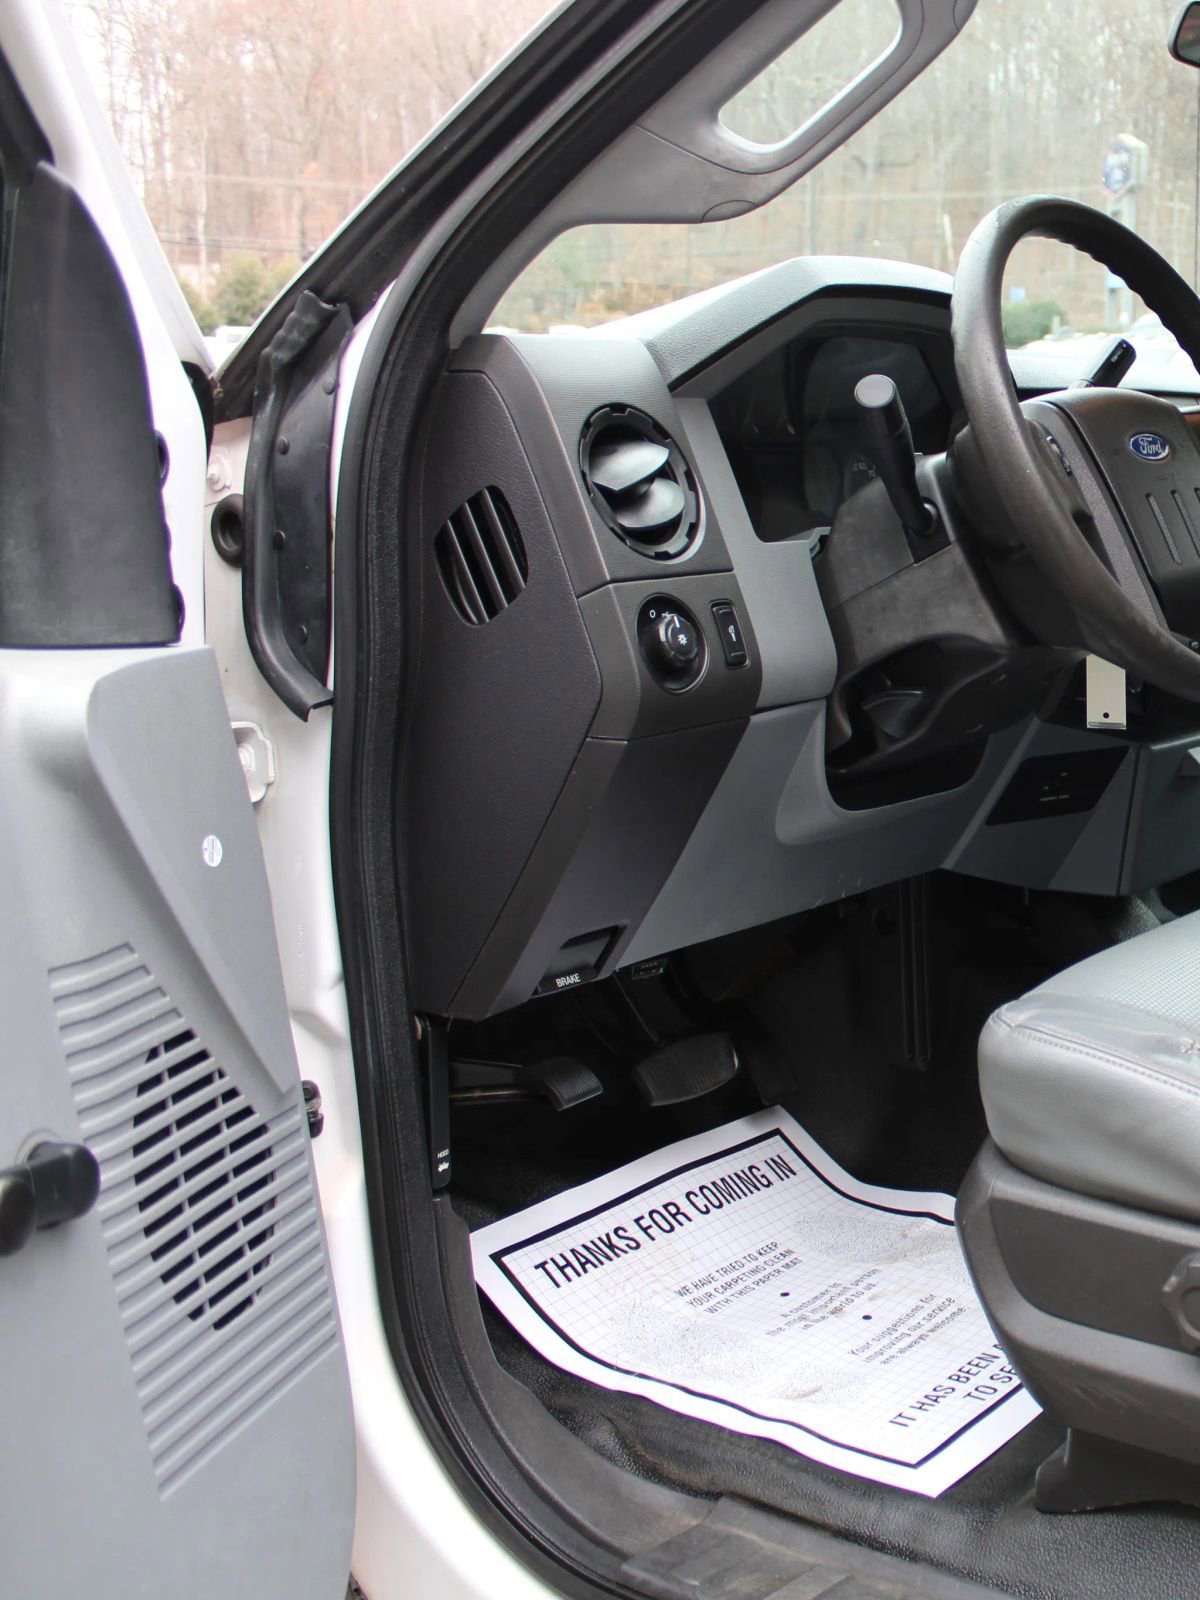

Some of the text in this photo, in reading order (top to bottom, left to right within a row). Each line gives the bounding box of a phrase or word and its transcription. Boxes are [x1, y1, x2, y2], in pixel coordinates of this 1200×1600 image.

[1138, 436, 1164, 455] Ford
[555, 973, 581, 988] BRAKE
[534, 1154, 797, 1289] THANKS FOR COMING IN
[674, 1241, 779, 1298] WE HAVE TRIED TO KEEP
[687, 1248, 795, 1308] YOUR CARPETING CLEAN
[704, 1257, 803, 1314] WITH THIS PAPER MAT
[827, 1297, 855, 1316] world
[848, 1341, 873, 1356] Your
[920, 1293, 937, 1304] for
[907, 1321, 925, 1333] our
[922, 1297, 956, 1323] service
[889, 1352, 1001, 1427] IT HAS BEEN
[963, 1384, 998, 1401] TO
